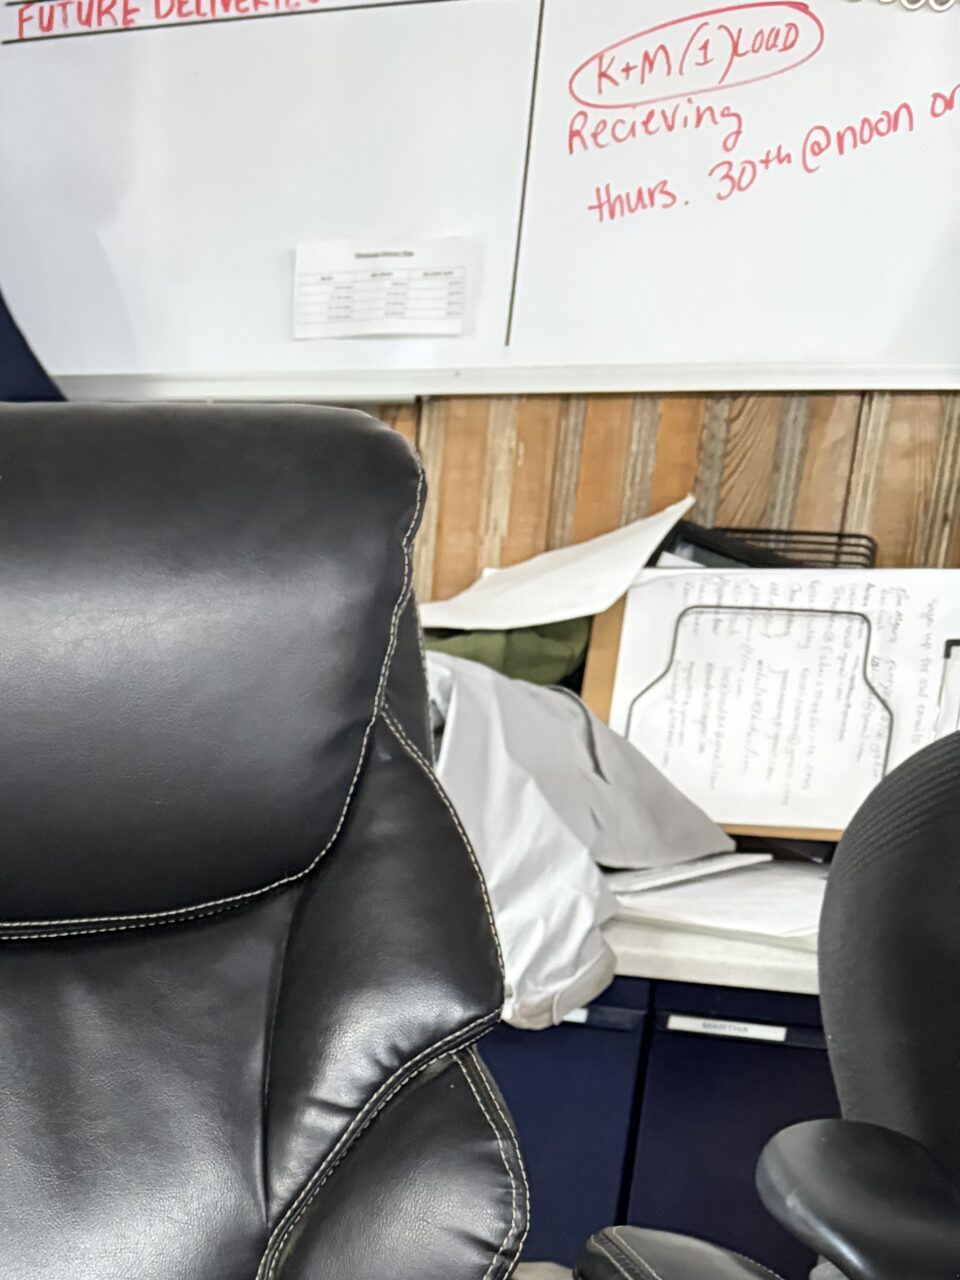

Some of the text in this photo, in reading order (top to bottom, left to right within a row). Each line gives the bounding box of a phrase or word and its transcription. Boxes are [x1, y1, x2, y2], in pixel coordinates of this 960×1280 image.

[17, 0, 139, 40] FUTURE
[568, 97, 743, 154] Recieving
[587, 179, 690, 222] thurs.
